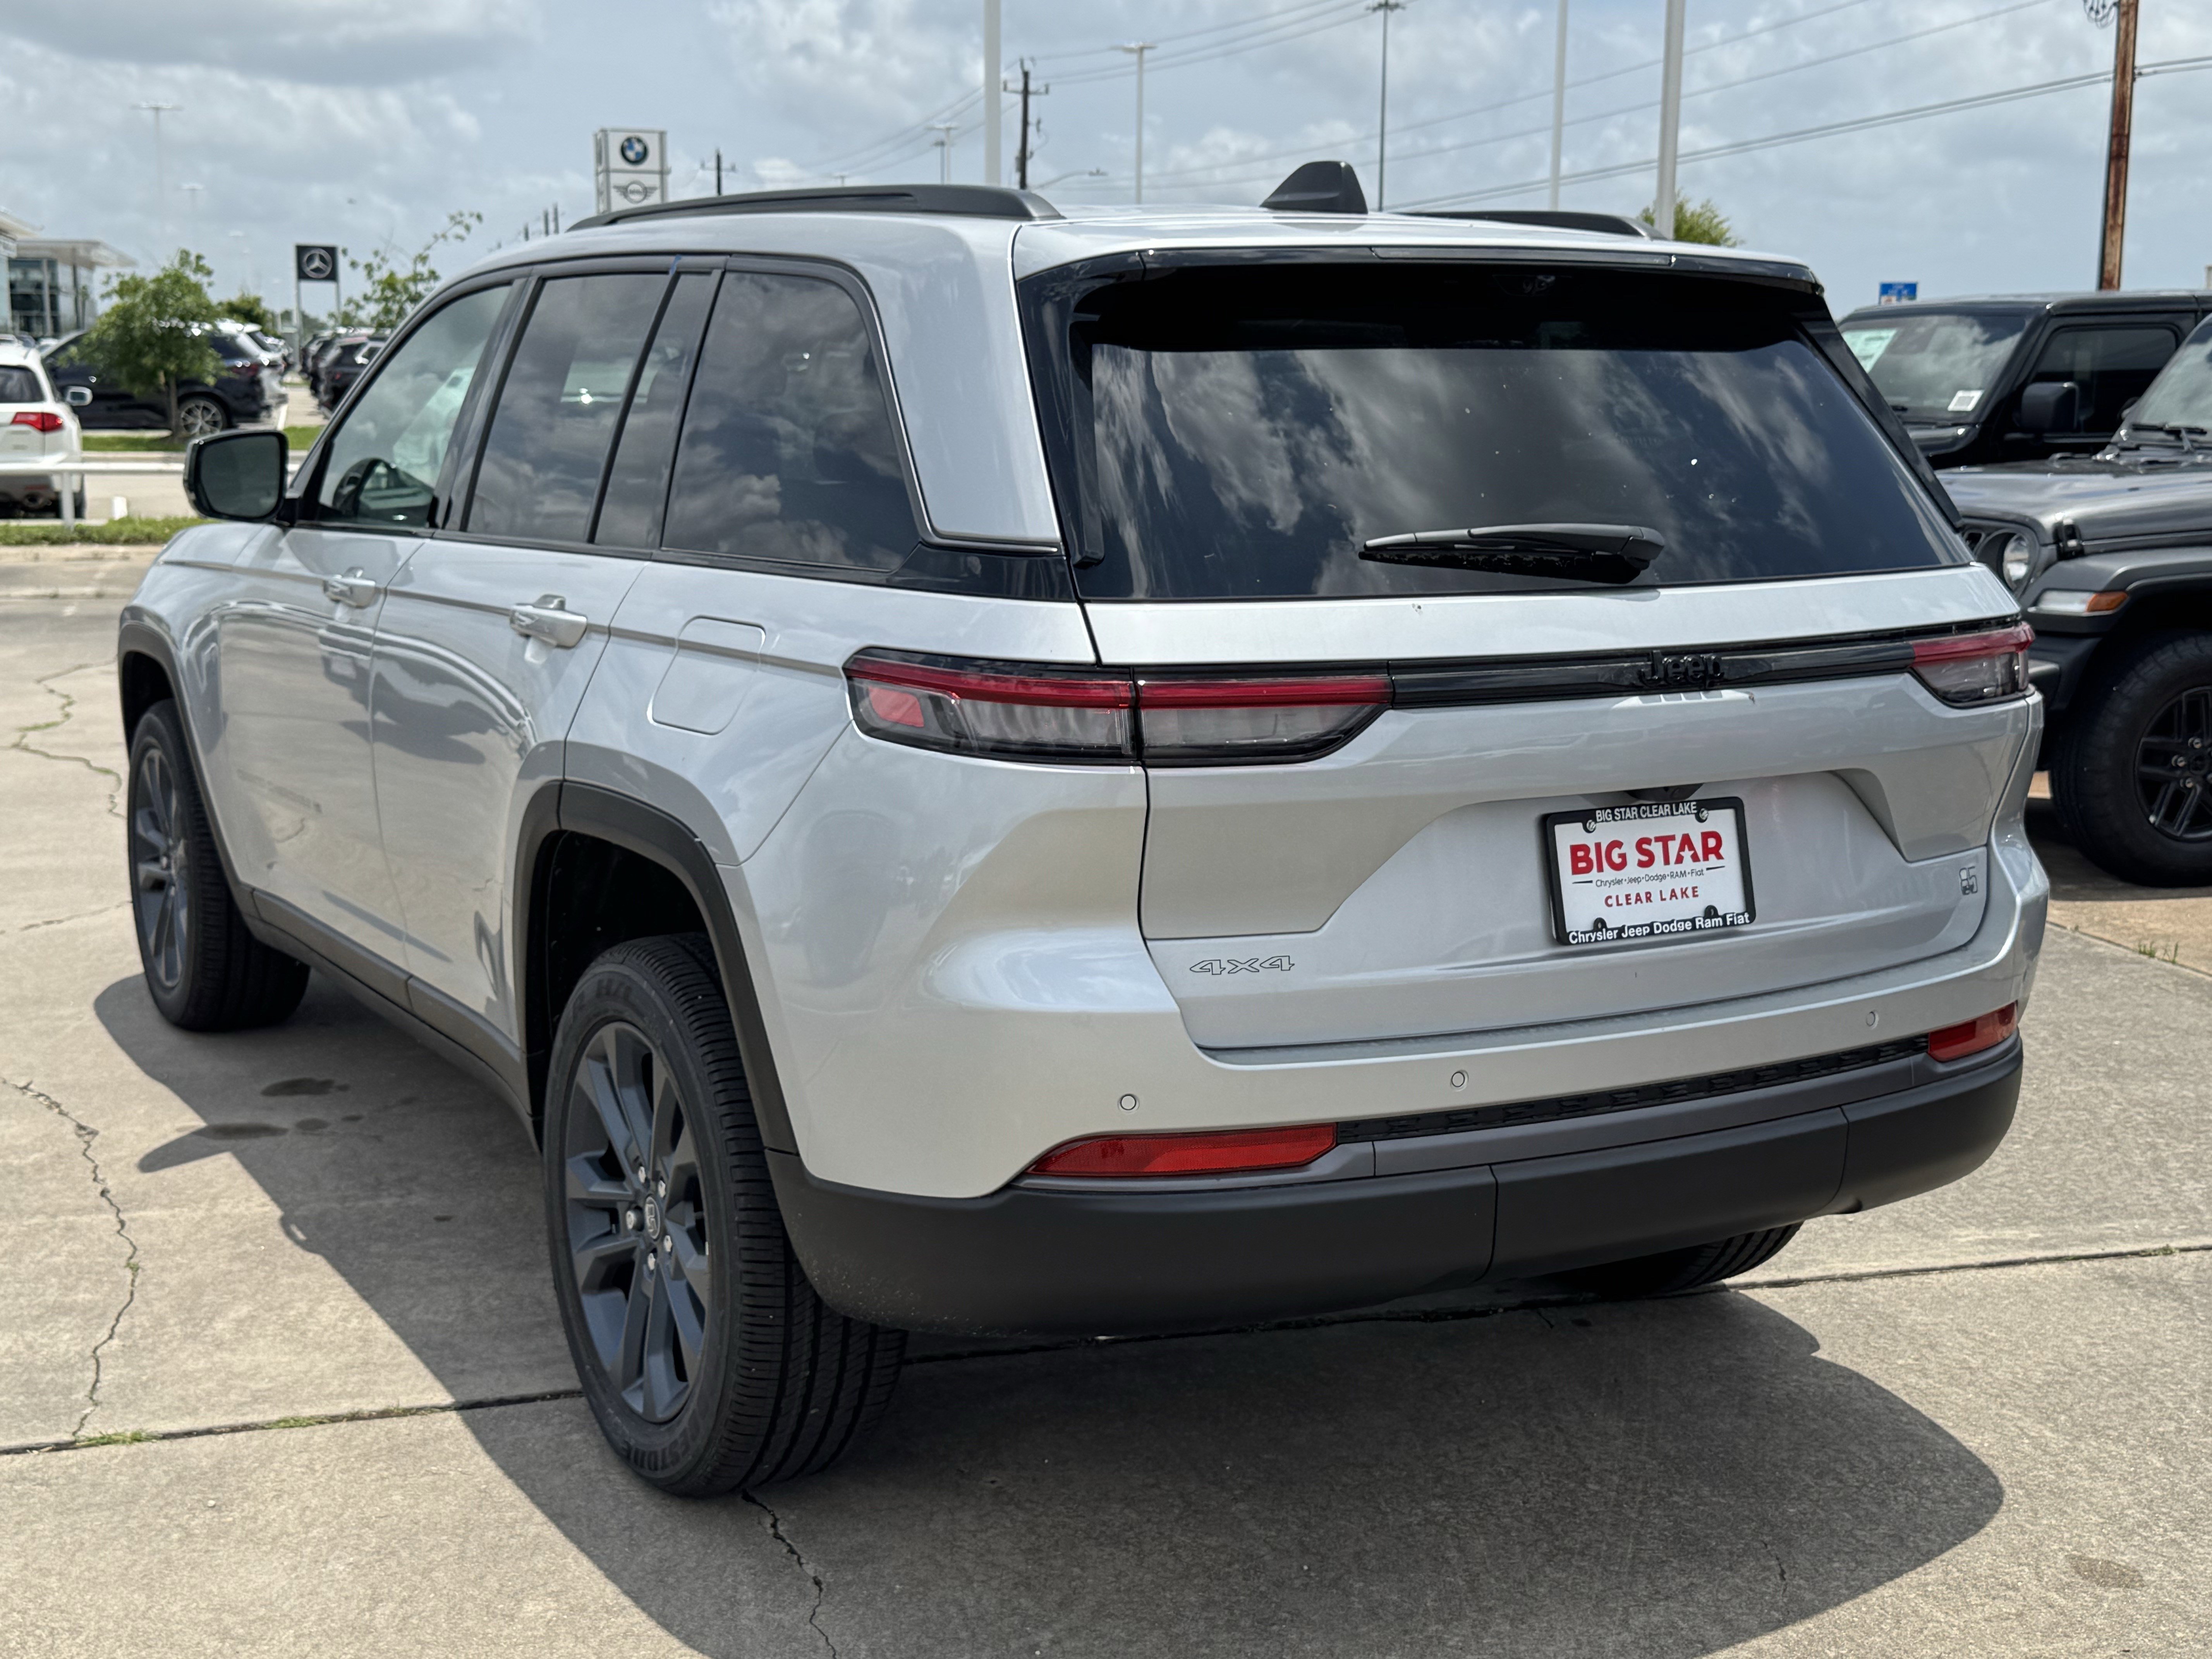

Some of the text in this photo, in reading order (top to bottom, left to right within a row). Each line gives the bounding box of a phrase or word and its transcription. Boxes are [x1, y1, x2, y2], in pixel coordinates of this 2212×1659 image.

[1639, 650, 1724, 689] Jeep
[1595, 801, 1697, 822] BIG STAR CLEAR LAKE
[1570, 830, 1724, 875] BIG STAR
[1604, 886, 1699, 907] CLEAR LAKE
[1569, 911, 1750, 944] Chrysler Jeep Dodge Ram Fiat
